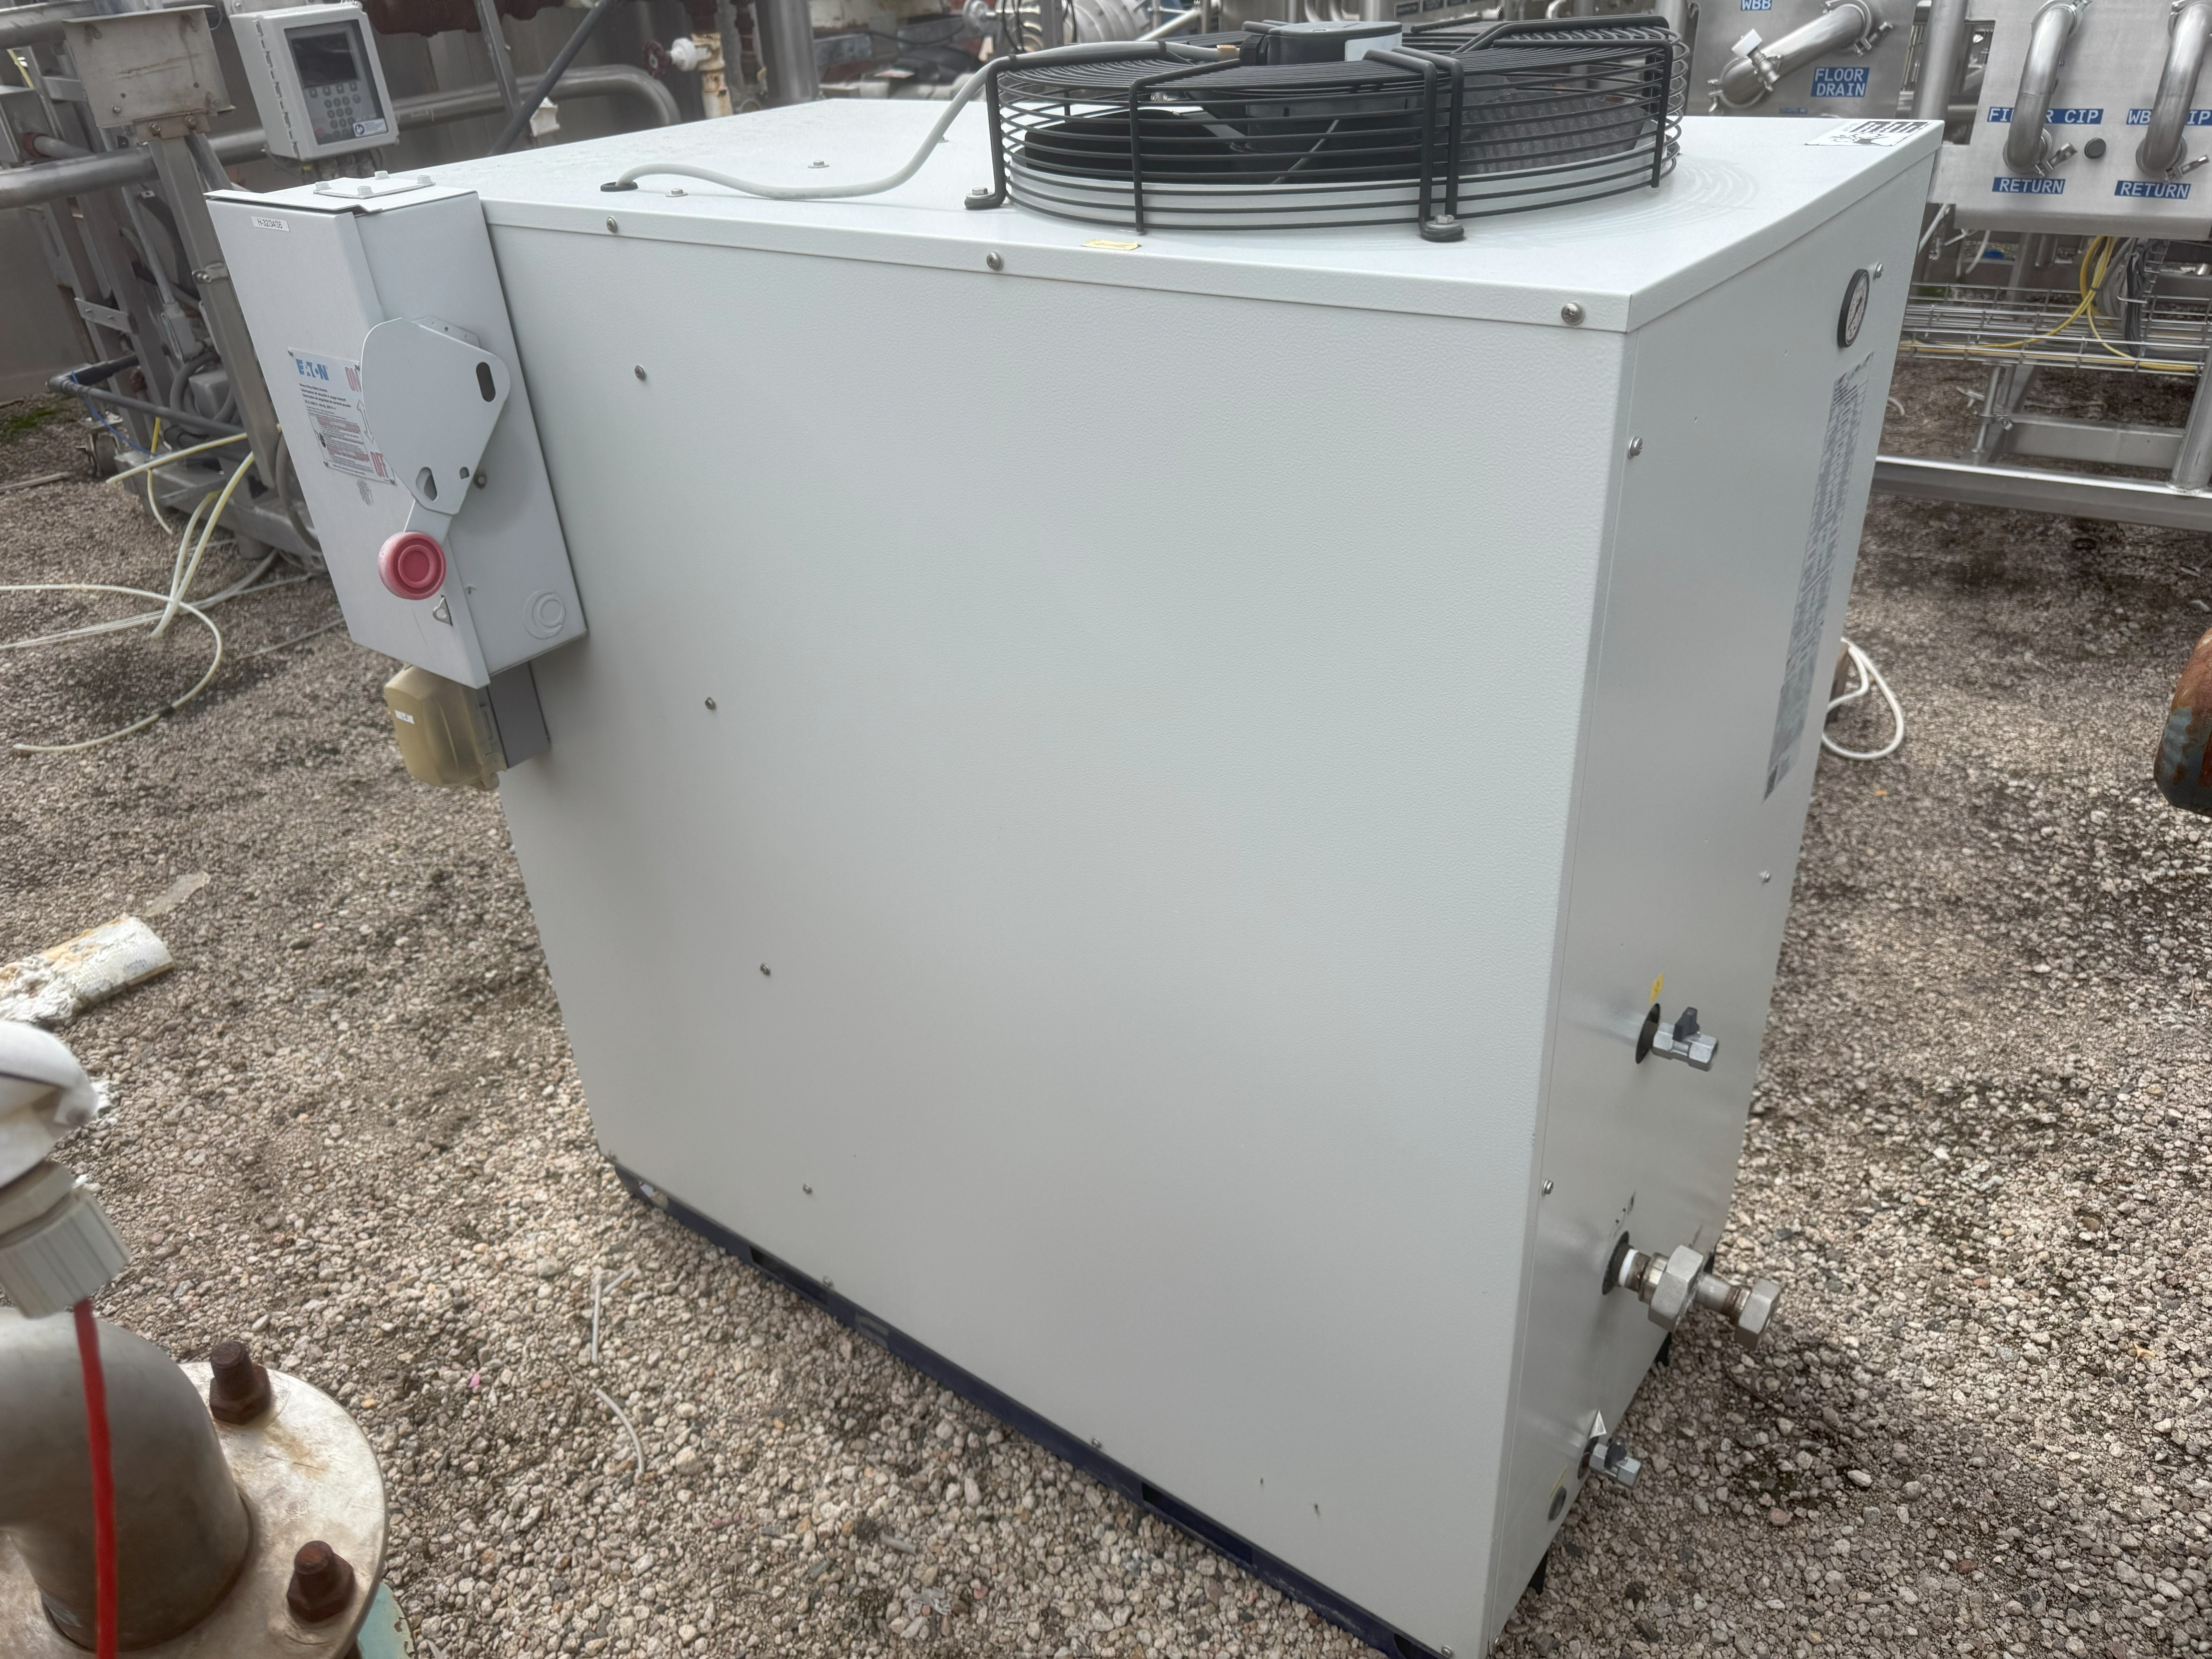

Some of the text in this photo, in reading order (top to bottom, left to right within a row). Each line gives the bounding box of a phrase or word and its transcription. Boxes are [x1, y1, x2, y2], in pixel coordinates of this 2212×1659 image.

[1742, 0, 1771, 10] WBB
[1815, 68, 1864, 82] FLOOR
[1816, 83, 1865, 96] DRAIN
[2064, 110, 2099, 123] CIP
[1999, 179, 2064, 193] RETURN
[2120, 182, 2189, 198] RETURN
[345, 366, 362, 393] ON
[370, 451, 389, 478] OFF
